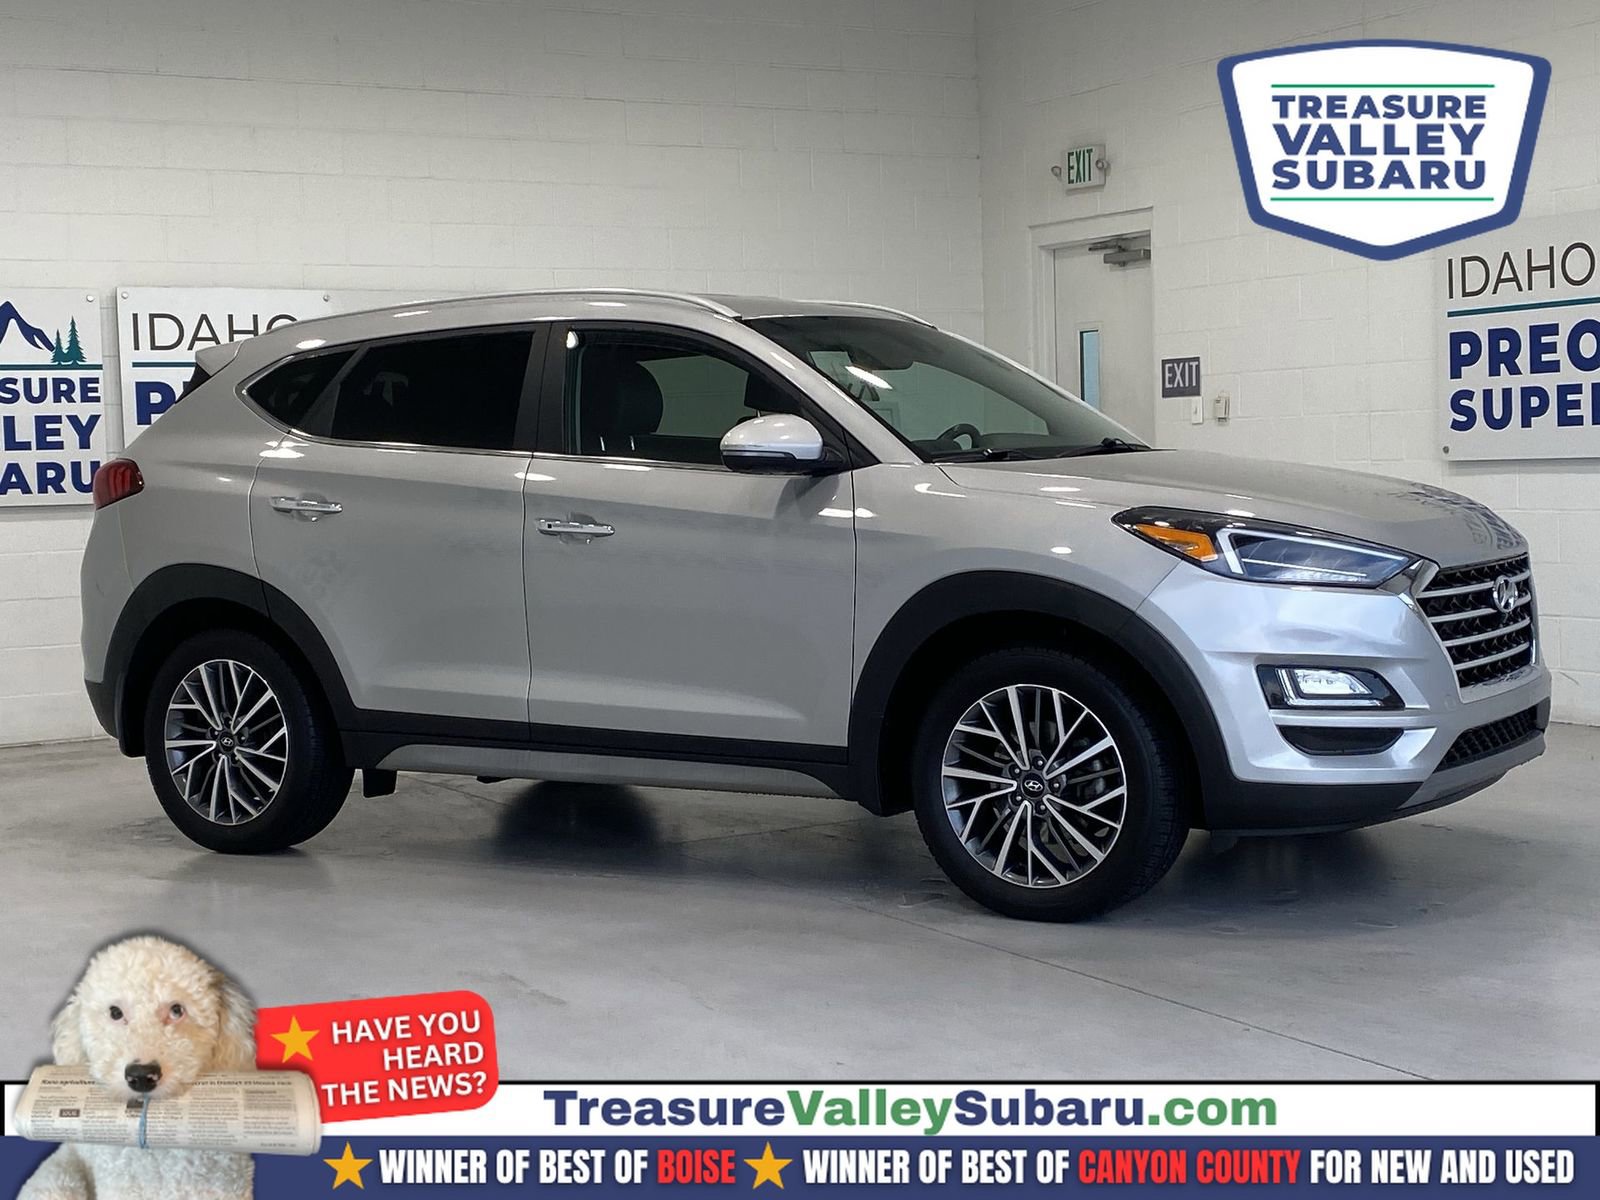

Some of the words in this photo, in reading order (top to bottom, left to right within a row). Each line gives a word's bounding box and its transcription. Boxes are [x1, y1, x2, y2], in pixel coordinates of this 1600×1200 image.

[1067, 148, 1094, 184] EXIT
[1447, 242, 1596, 299] IDAHO
[0, 377, 101, 404] SURE
[1165, 361, 1199, 389] EXIT
[1450, 382, 1600, 432] SUPE
[2, 414, 102, 451] LEY
[0, 460, 100, 495] ARU
